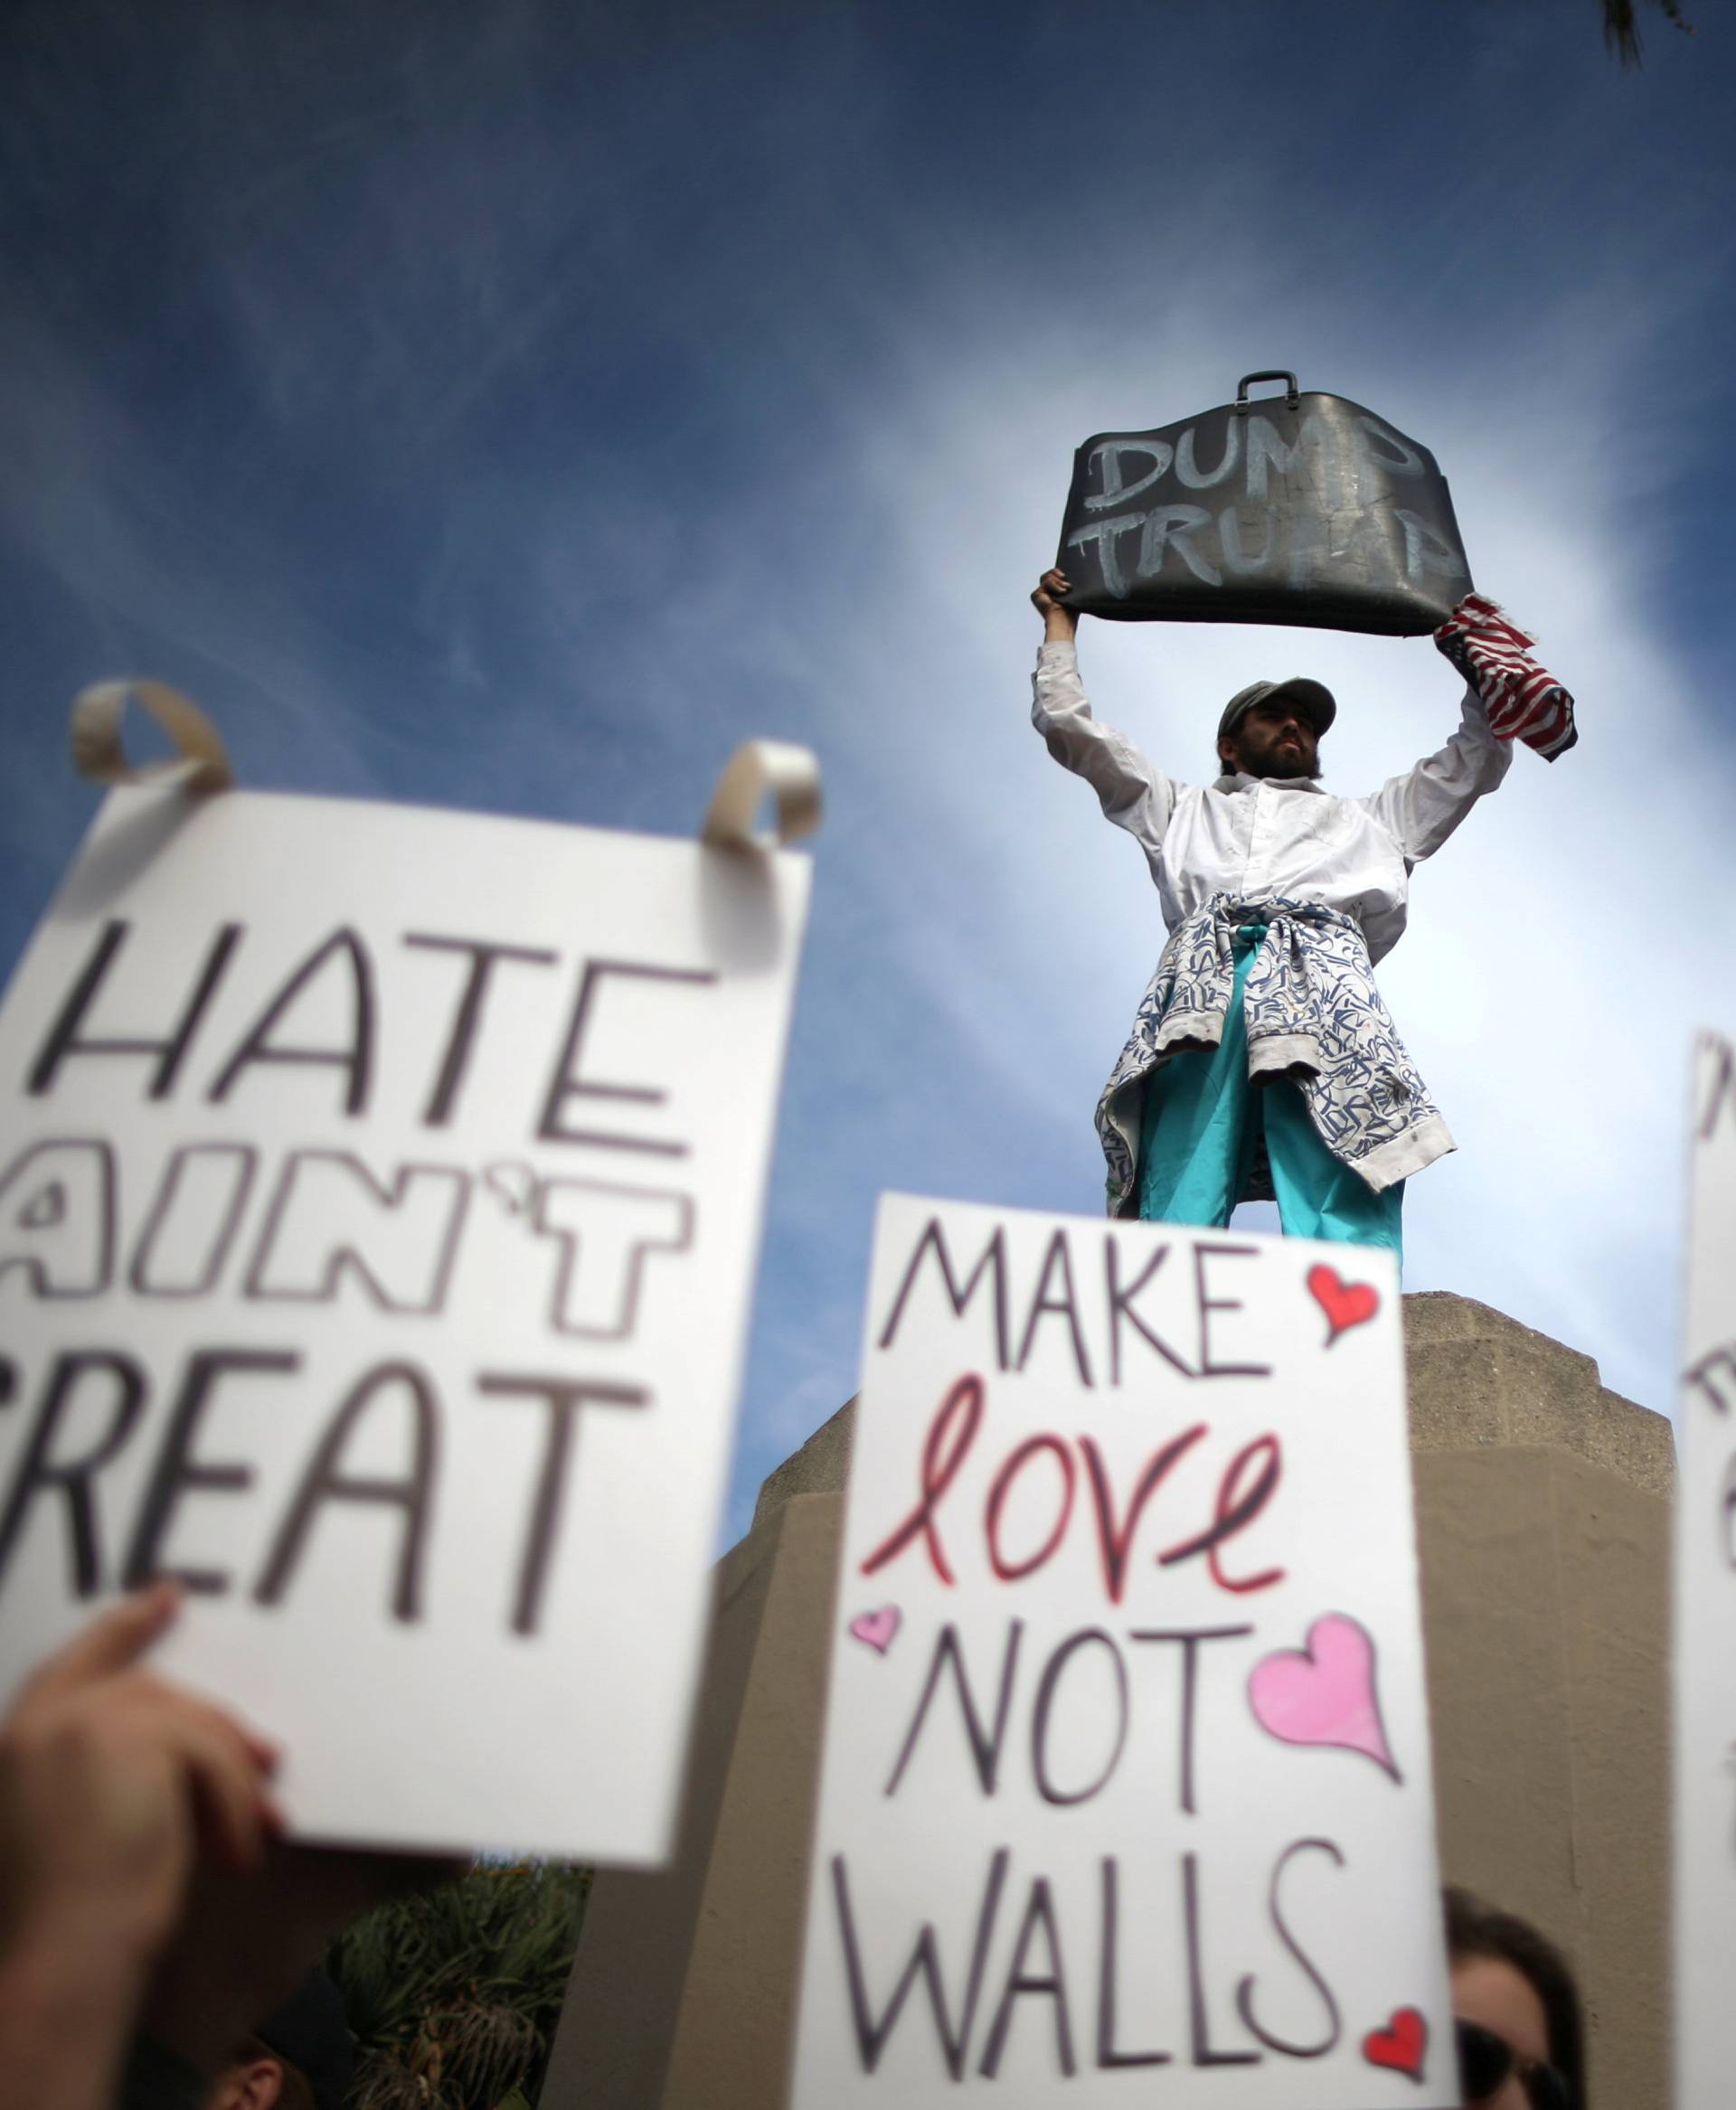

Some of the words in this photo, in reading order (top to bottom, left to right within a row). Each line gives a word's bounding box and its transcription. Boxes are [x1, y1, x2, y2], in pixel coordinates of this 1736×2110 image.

[1084, 415, 1426, 512] DUMP
[27, 918, 720, 1159] HATE
[0, 1136, 695, 1342] AIN'T
[878, 1217, 1273, 1389] MAKE
[0, 1345, 653, 1638] REAT
[885, 1617, 1254, 1814] NOT
[831, 1836, 1346, 2084] WALLS
